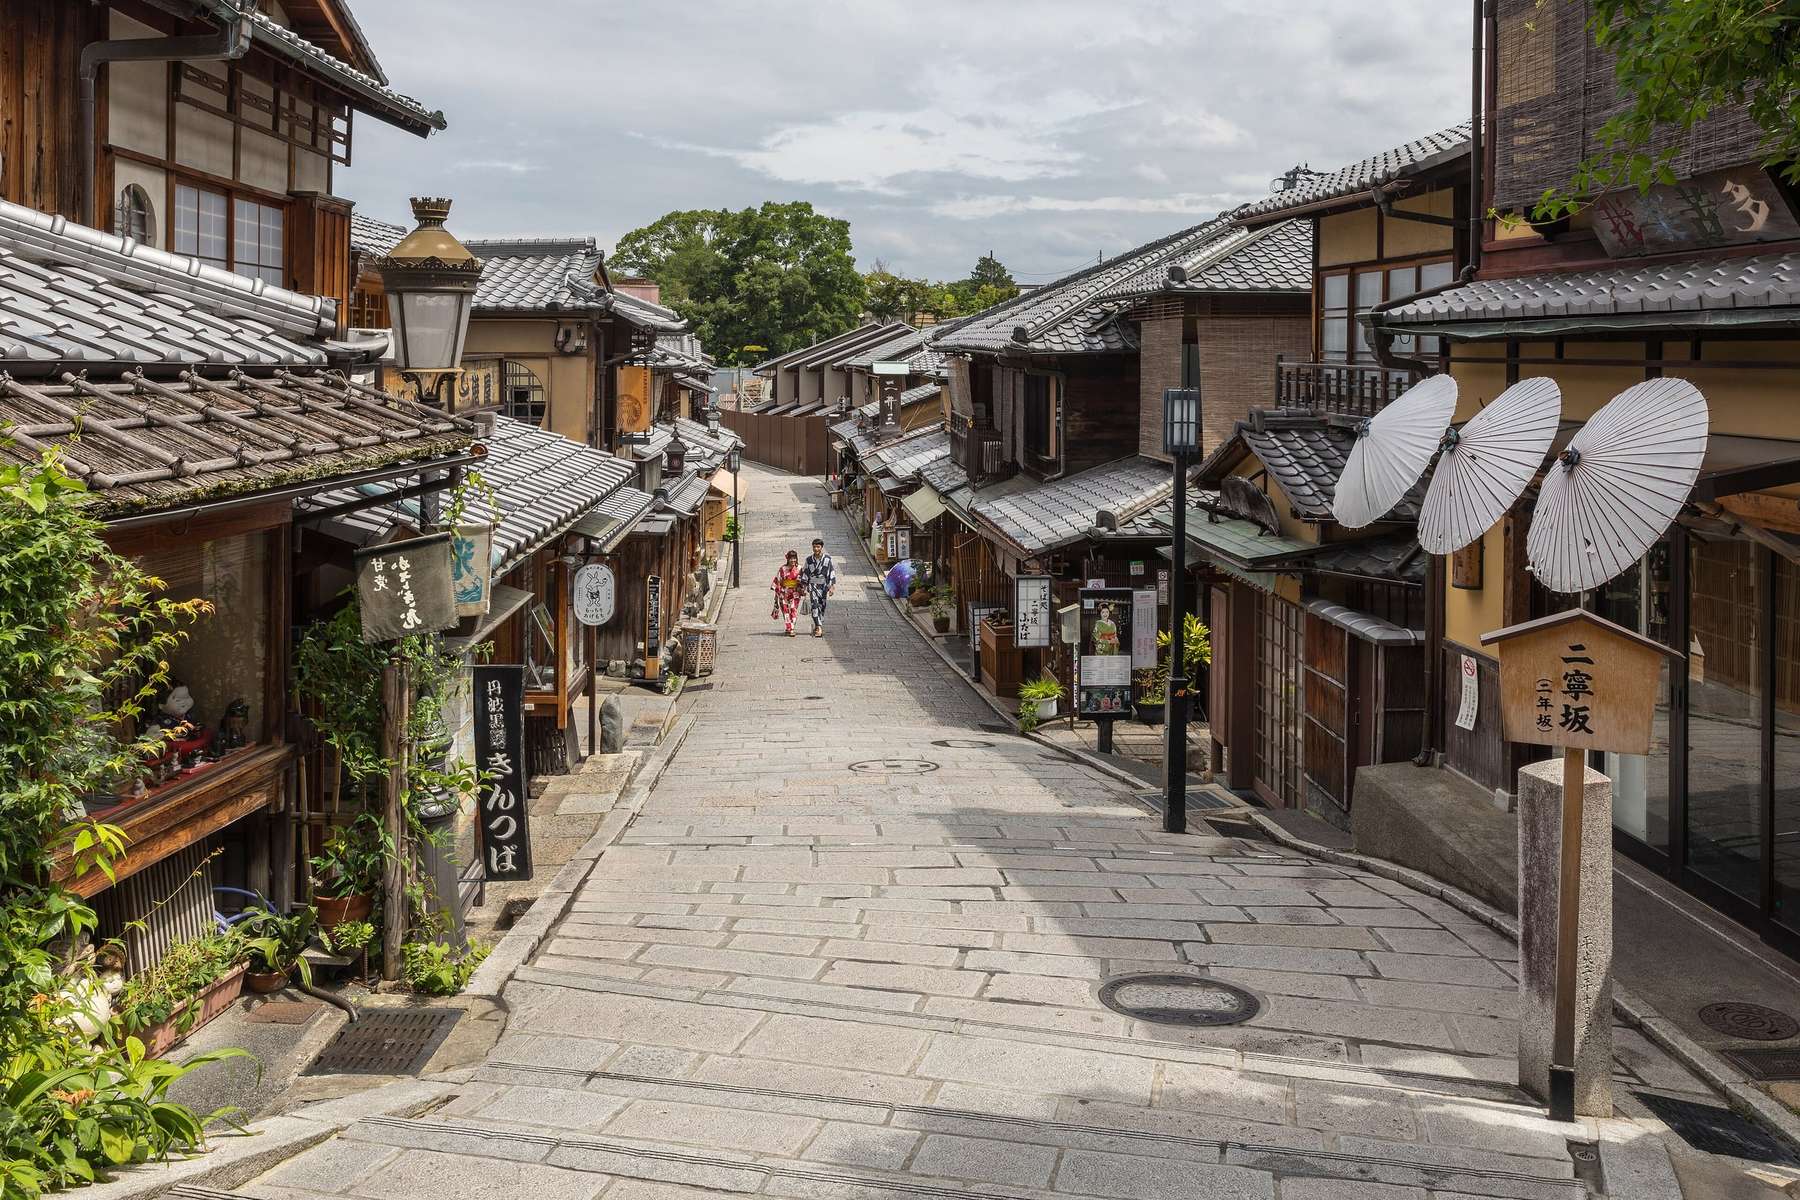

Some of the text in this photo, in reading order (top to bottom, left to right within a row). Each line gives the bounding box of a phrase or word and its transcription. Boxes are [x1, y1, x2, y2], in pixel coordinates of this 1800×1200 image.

[1040, 585, 1048, 610] そば処
[1020, 612, 1030, 640] ふたば
[1559, 644, 1595, 735] 二寧坂
